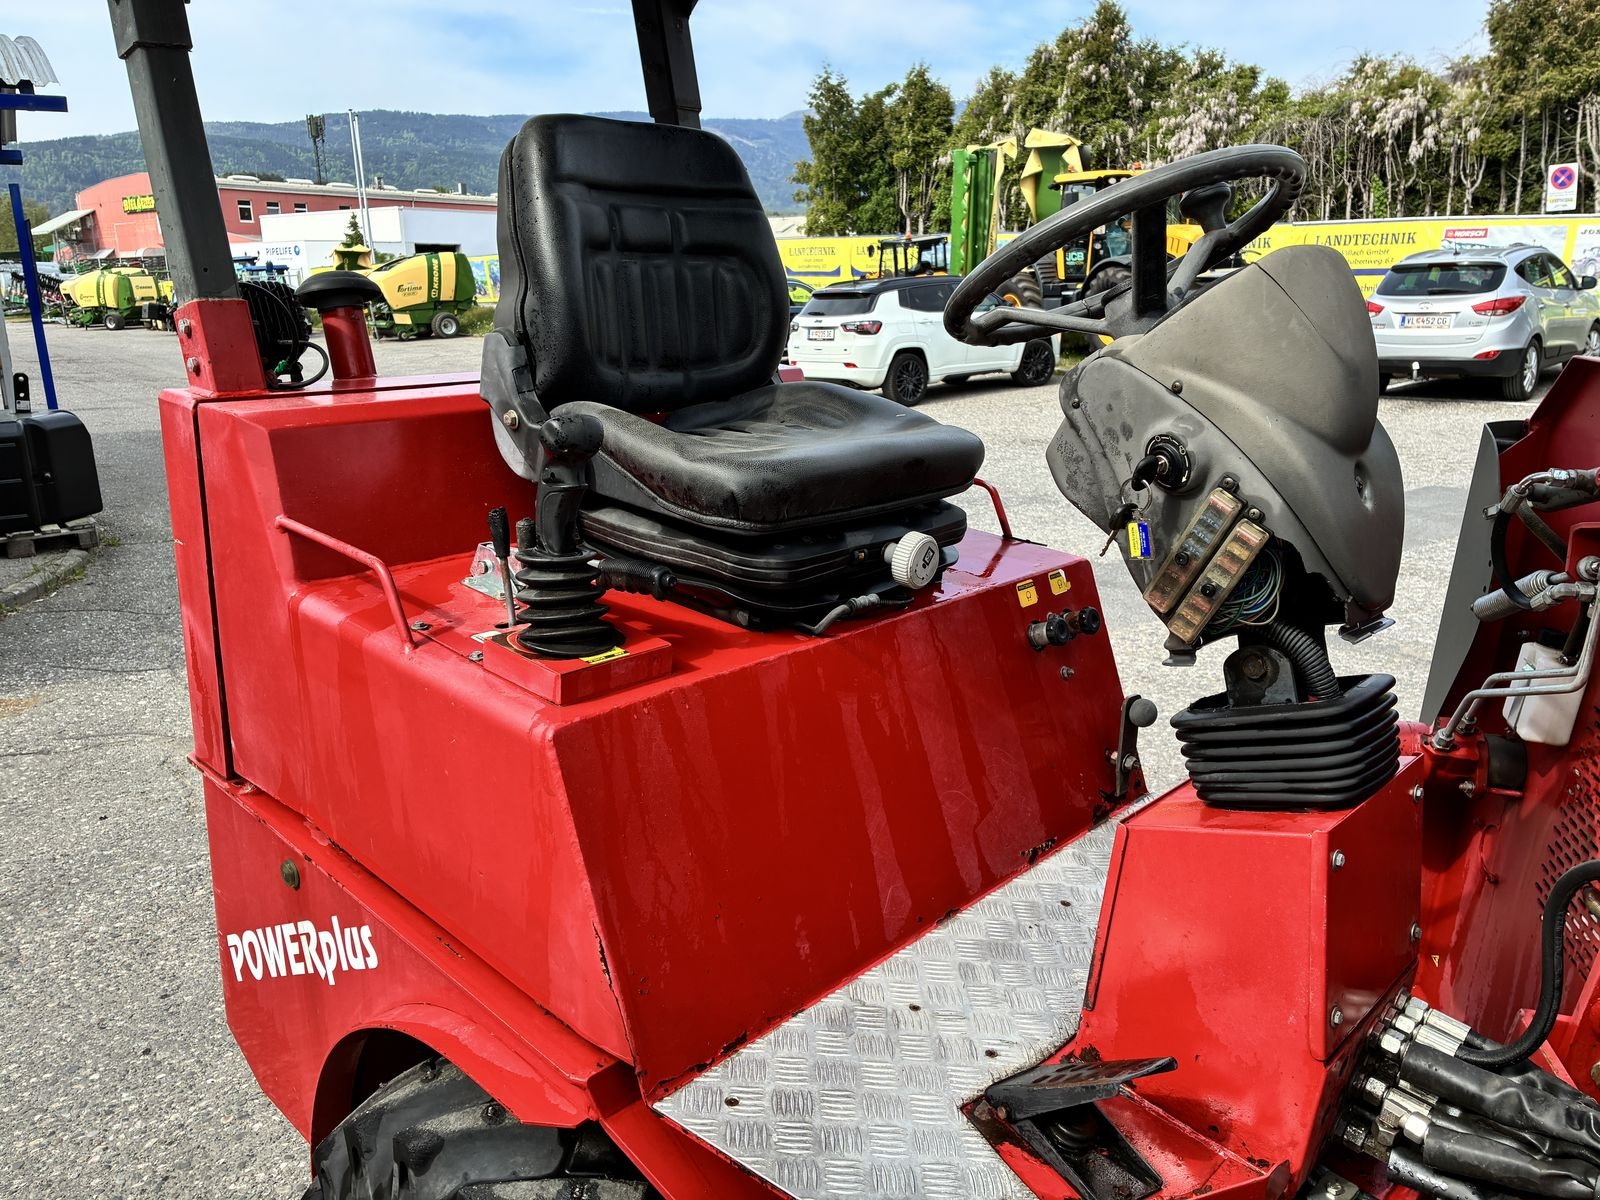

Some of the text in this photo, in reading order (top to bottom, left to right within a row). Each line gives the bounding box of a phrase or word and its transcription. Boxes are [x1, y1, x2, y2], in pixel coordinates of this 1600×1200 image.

[1454, 229, 1486, 238] HORSCH
[1315, 231, 1417, 247] LANDTECHNIK
[265, 246, 292, 256] PIPELIFE
[1066, 252, 1085, 262] JCB
[226, 914, 378, 986] POWERplus
